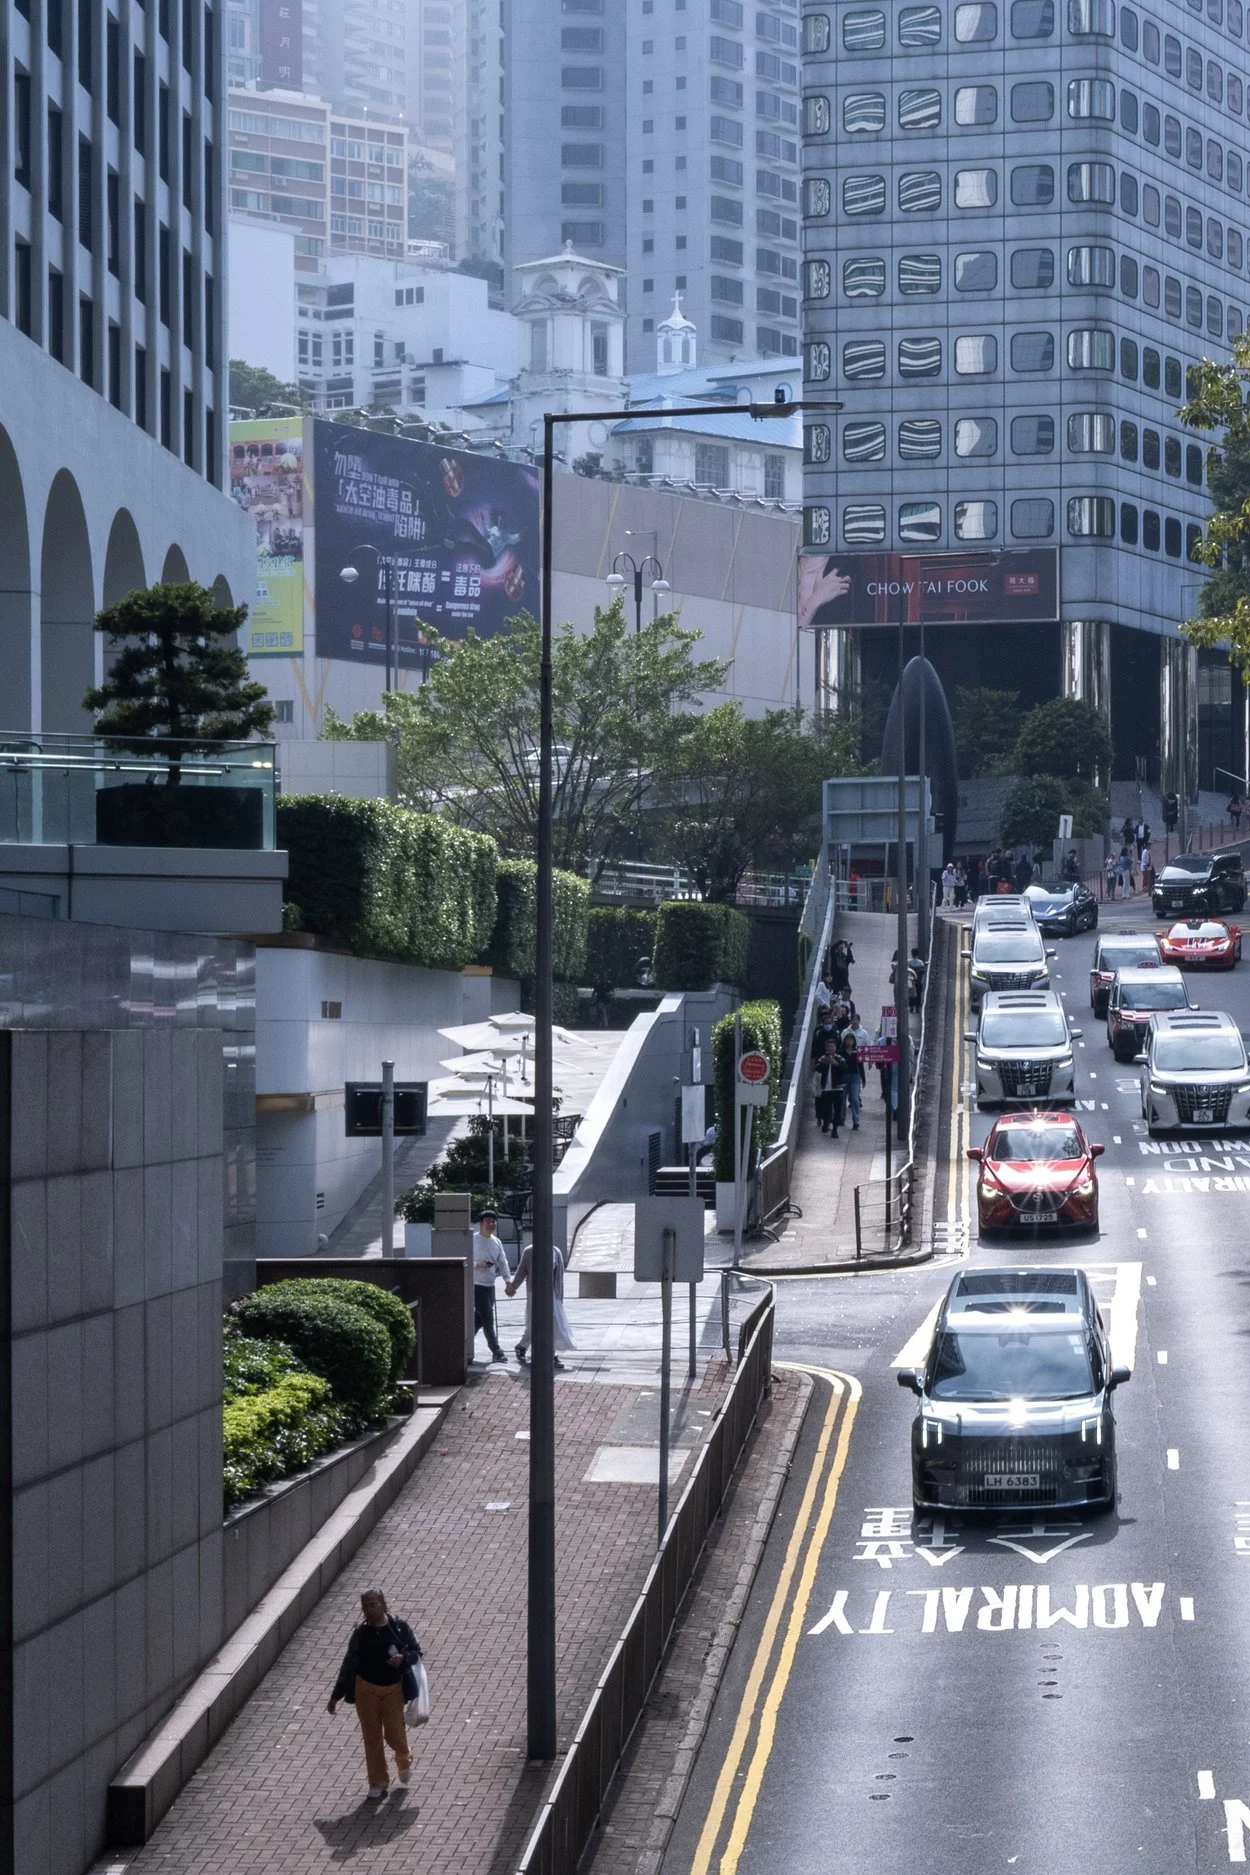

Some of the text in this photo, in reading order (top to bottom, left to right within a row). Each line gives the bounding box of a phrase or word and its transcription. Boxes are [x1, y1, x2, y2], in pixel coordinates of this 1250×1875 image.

[454, 575, 482, 597] 毒品
[866, 581, 915, 596] CHOW
[947, 579, 989, 593] FOOK
[986, 1477, 1038, 1486] LH 6383
[807, 1582, 1167, 1635] ADMIRALTY
